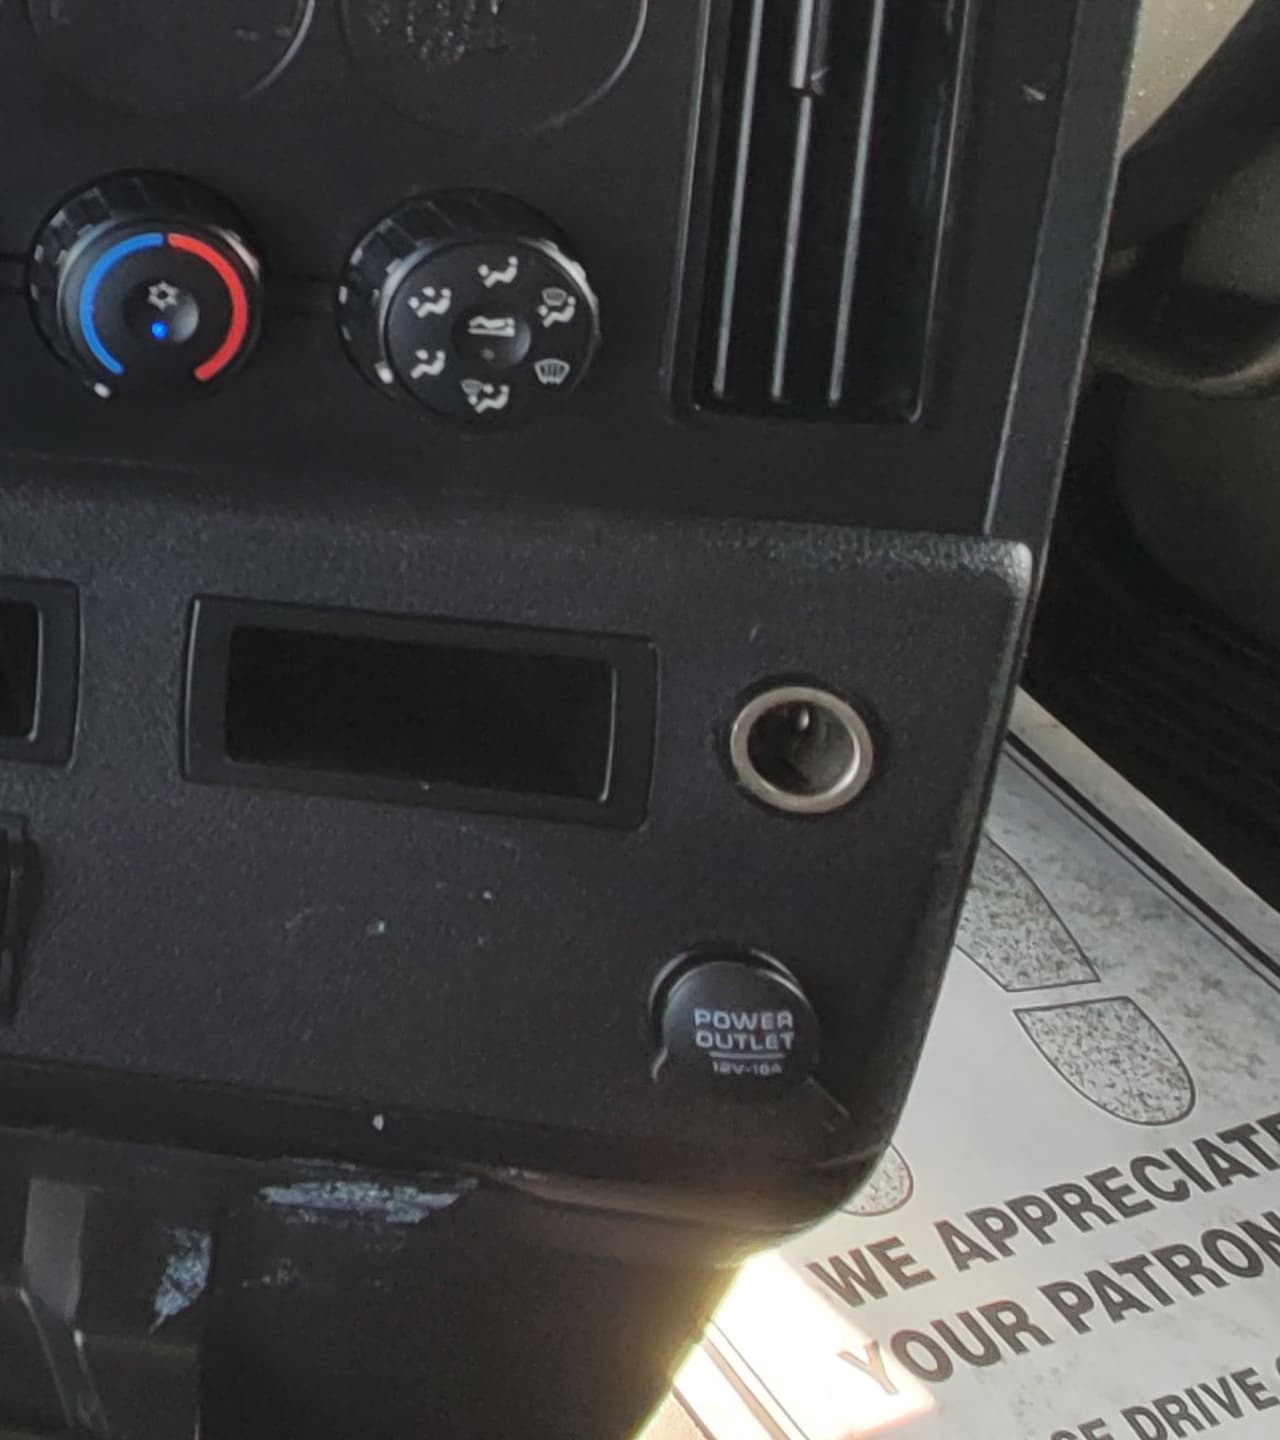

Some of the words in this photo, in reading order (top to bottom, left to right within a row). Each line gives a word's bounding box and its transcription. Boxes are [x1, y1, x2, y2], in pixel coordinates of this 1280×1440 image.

[693, 1007, 794, 1031] POWER
[694, 1029, 796, 1051] OUTLET
[806, 1236, 937, 1308] WE
[836, 1299, 1055, 1396] YOUR
[1120, 1367, 1280, 1440] DRIVE
